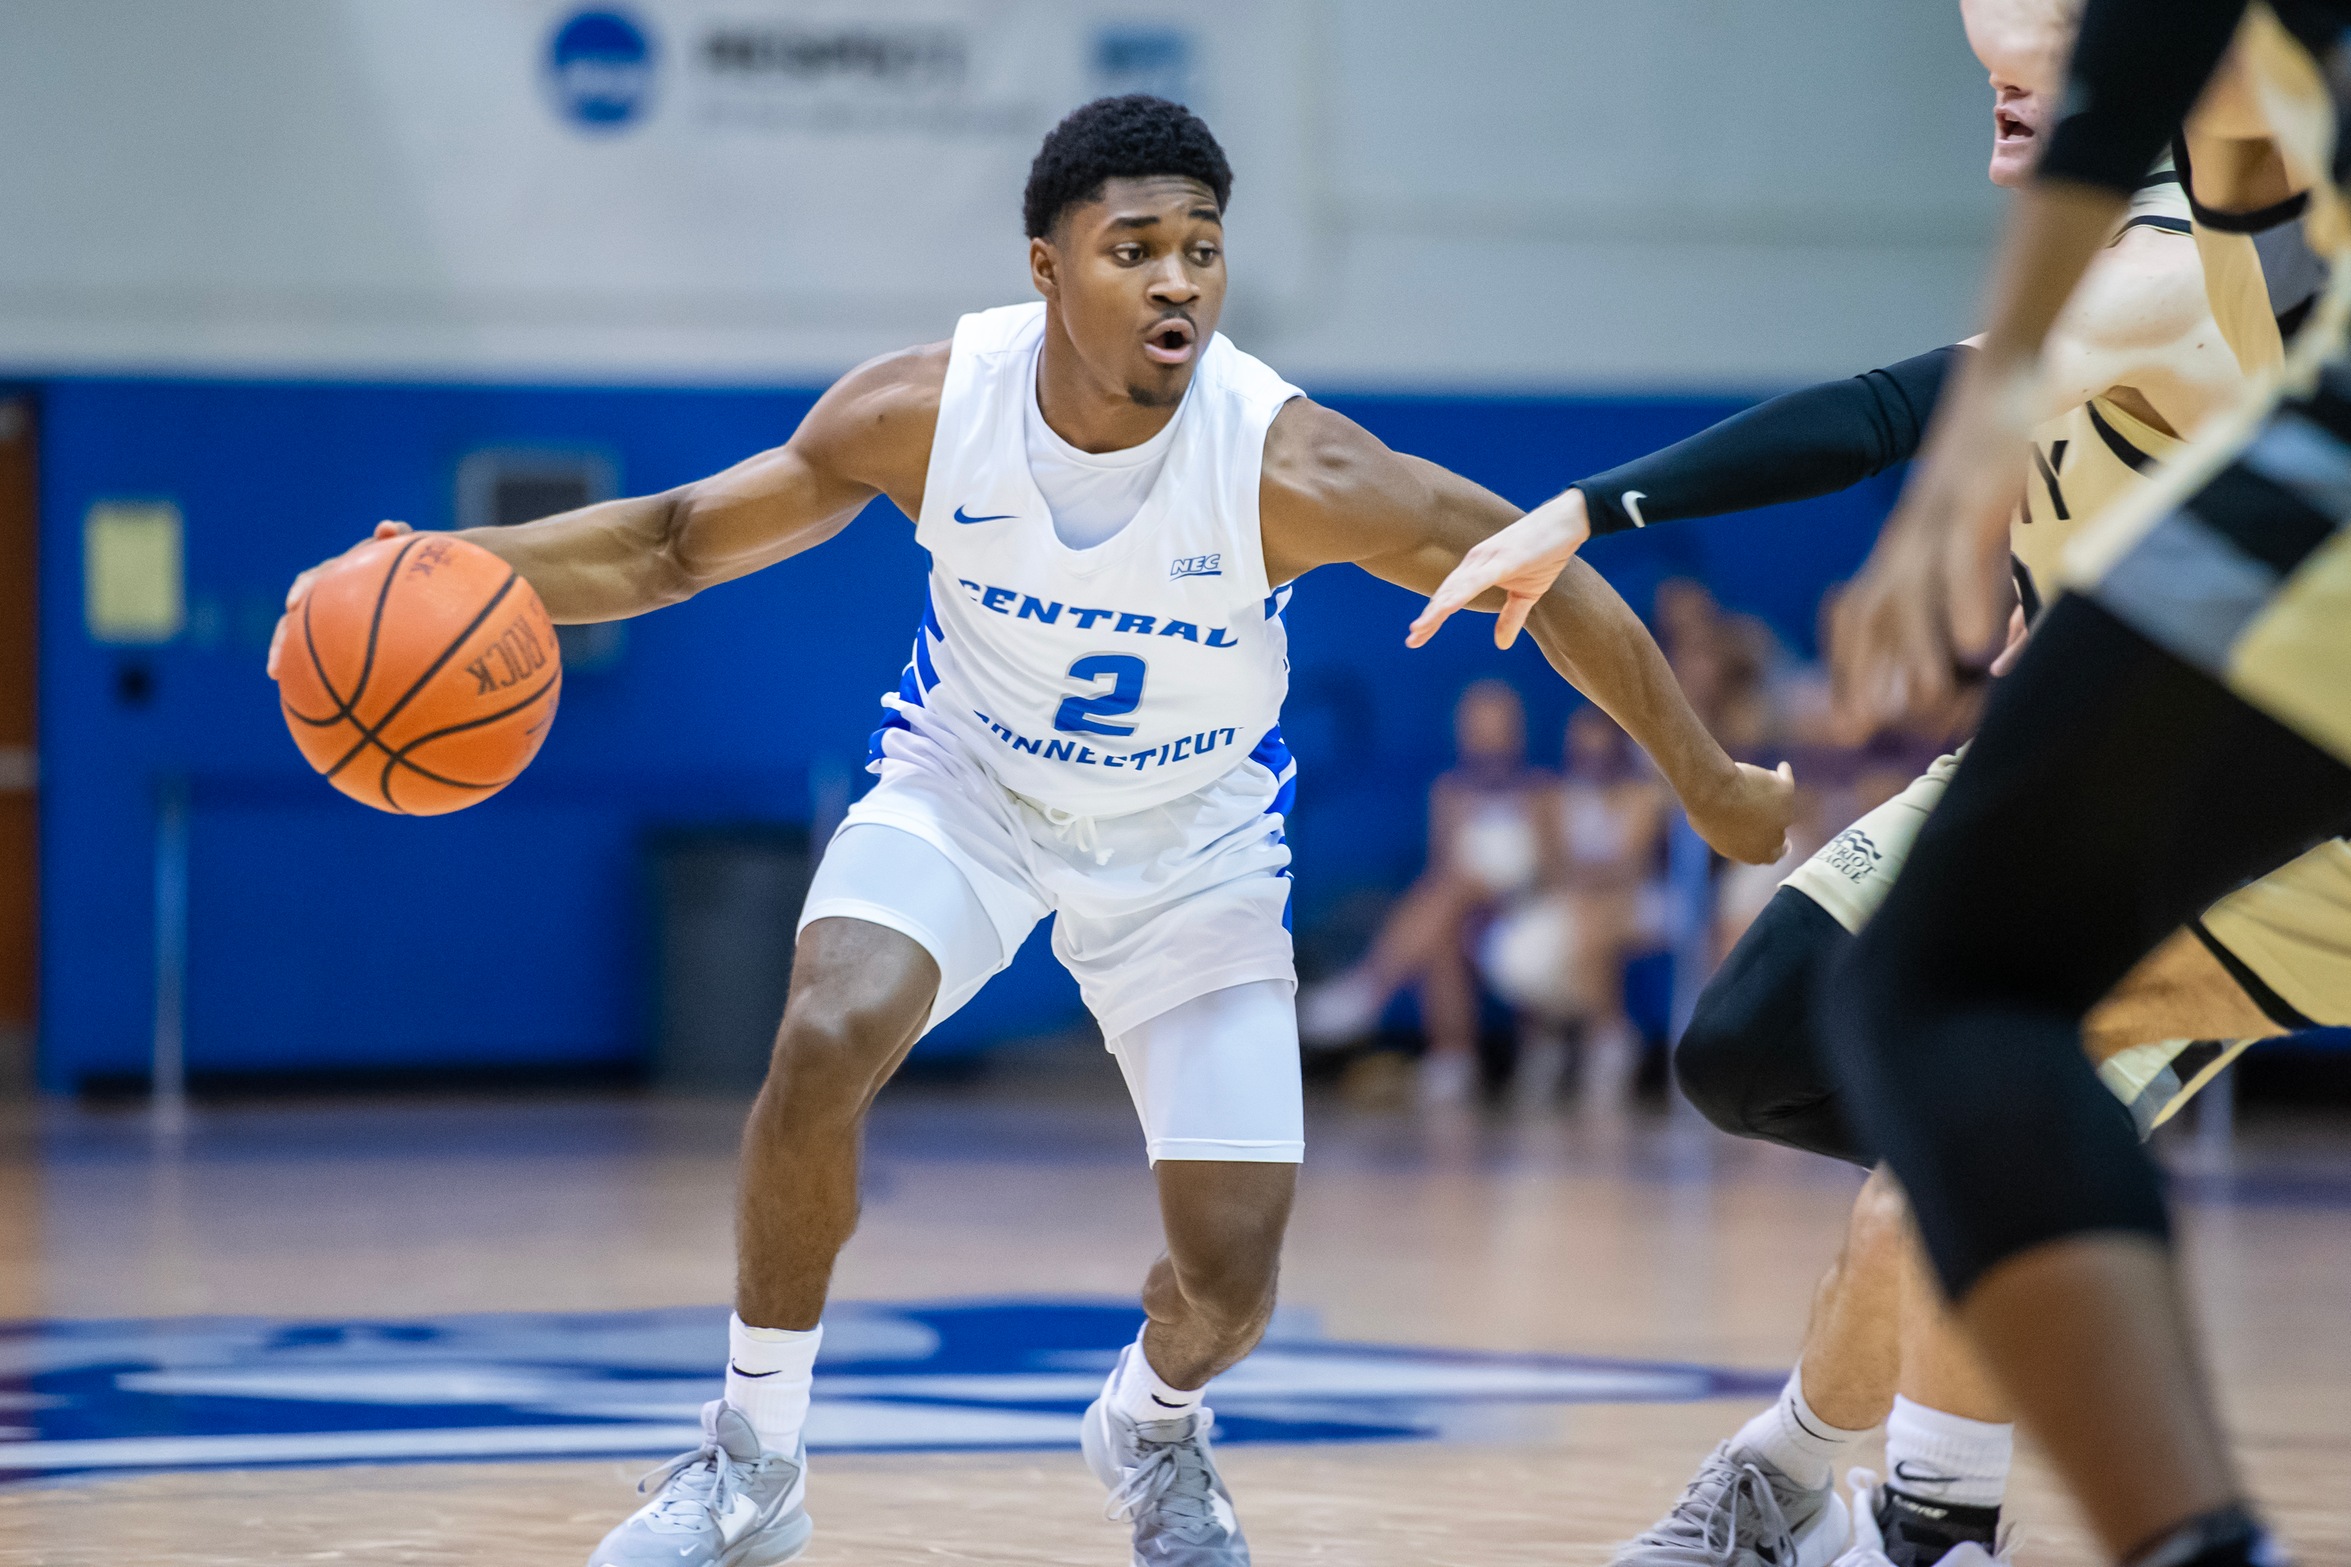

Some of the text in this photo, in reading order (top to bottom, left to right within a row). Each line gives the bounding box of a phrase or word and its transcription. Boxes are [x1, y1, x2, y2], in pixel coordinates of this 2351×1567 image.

[1170, 553, 1221, 576] NEC
[1051, 651, 1149, 737] 2
[973, 709, 1244, 771] ONNECTICUT
[1815, 850, 1864, 885] EAGUE
[1826, 844, 1878, 875] TRIOT
